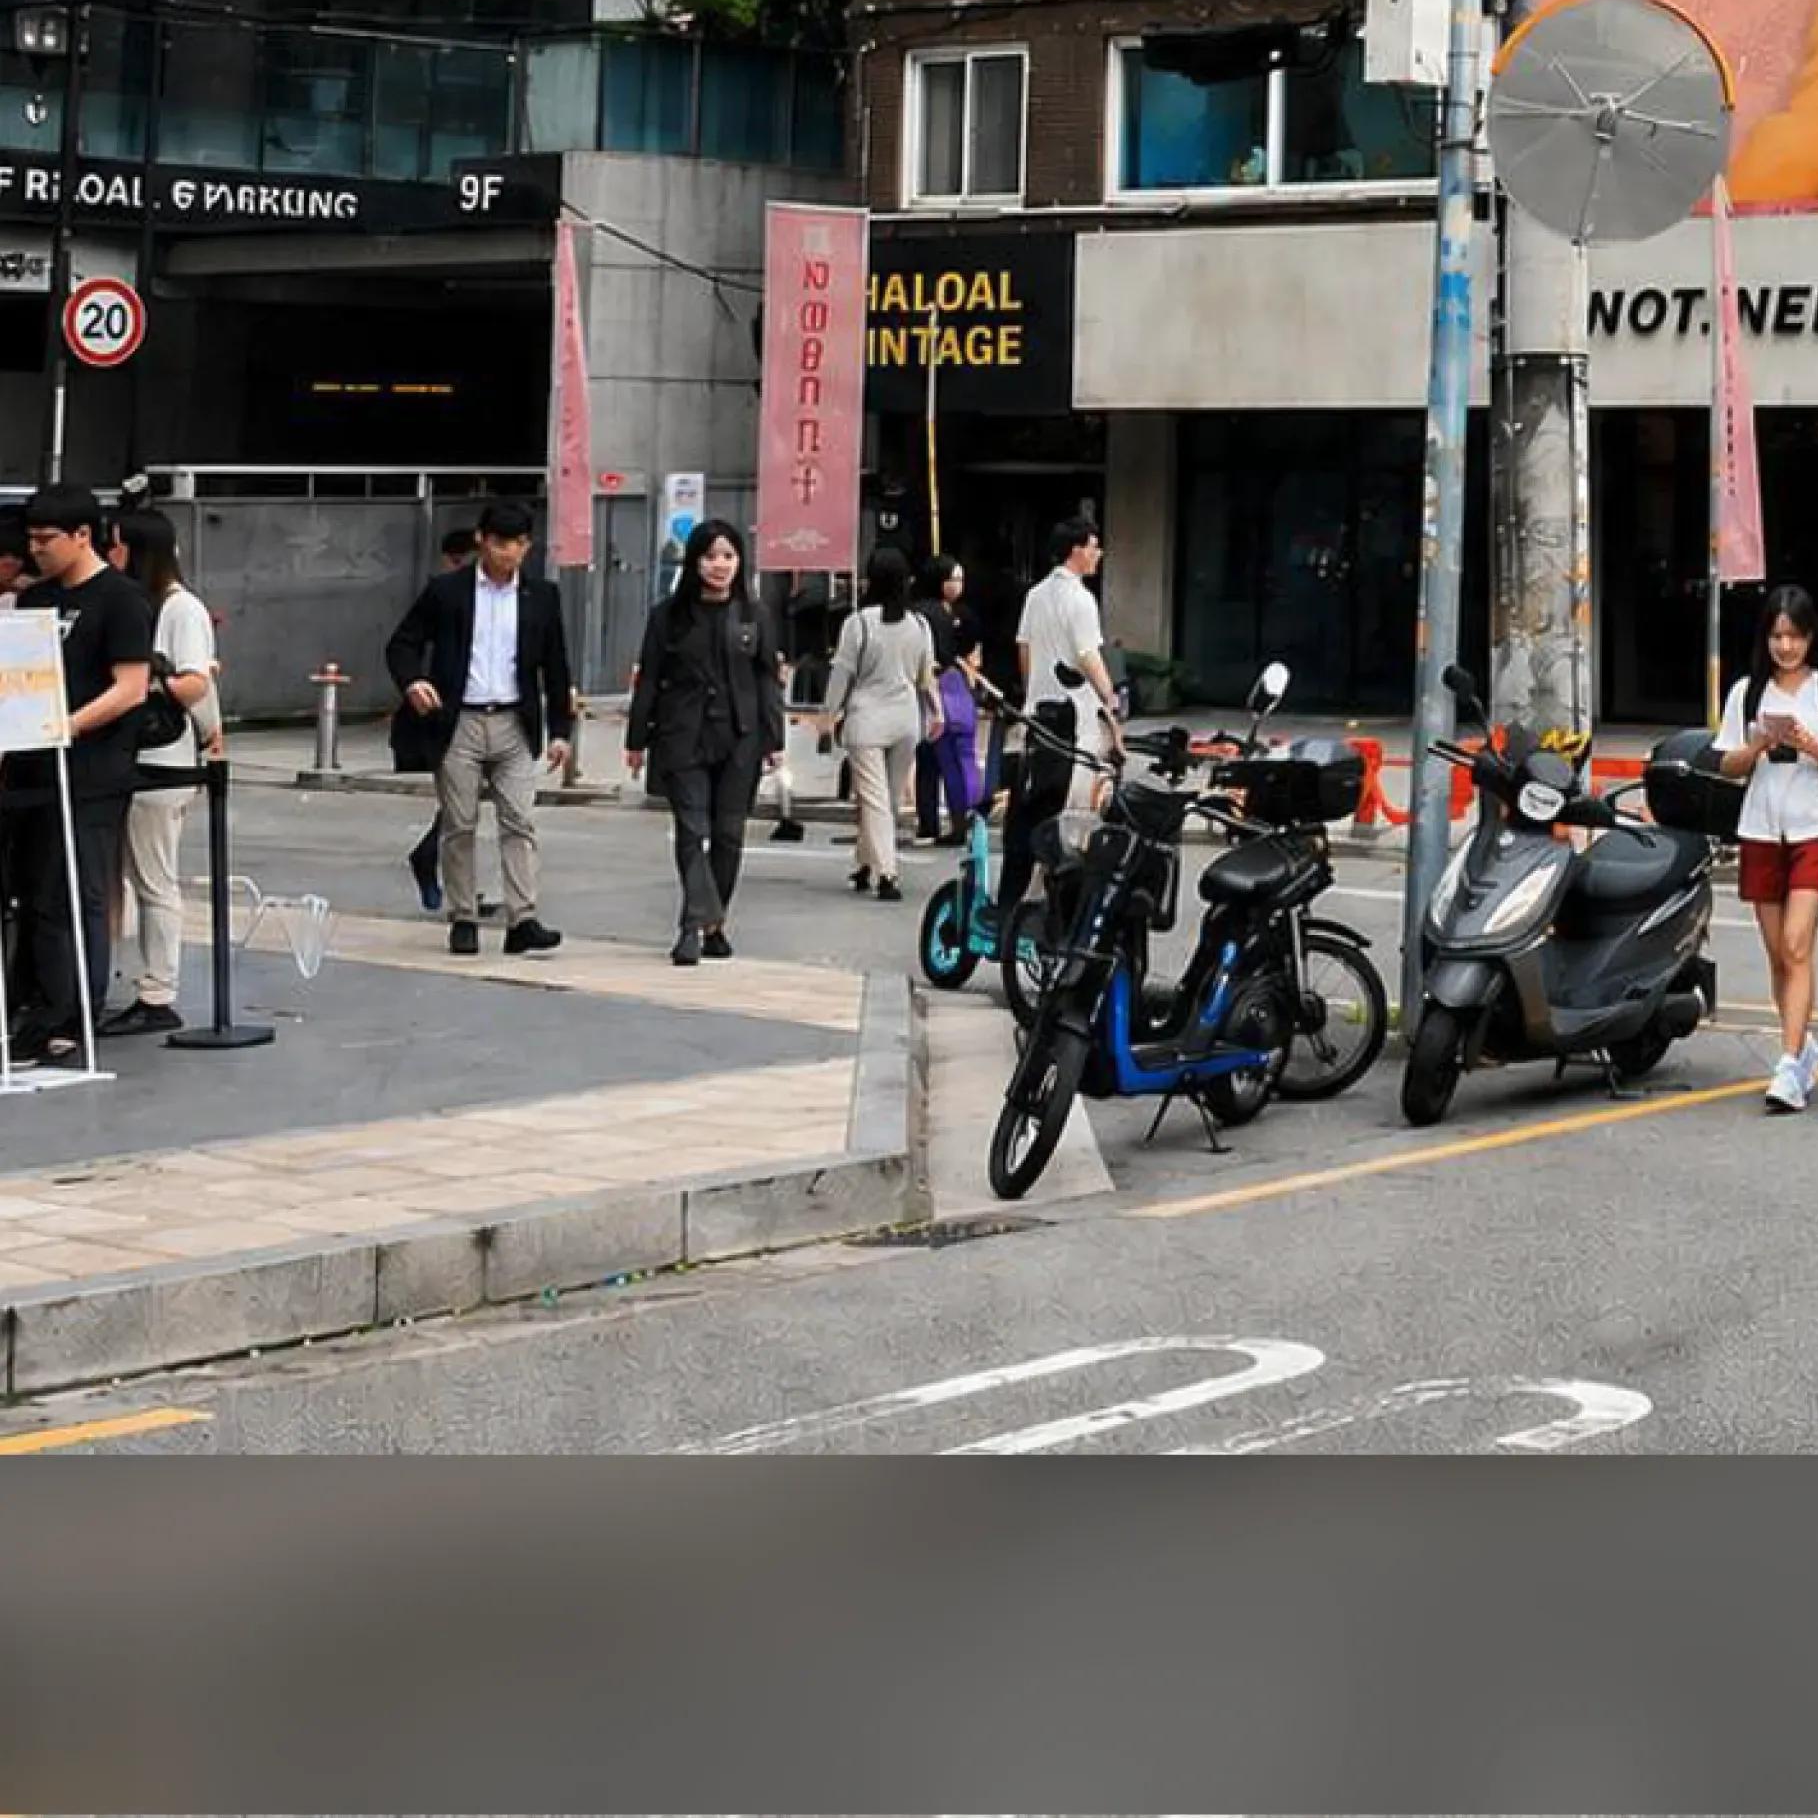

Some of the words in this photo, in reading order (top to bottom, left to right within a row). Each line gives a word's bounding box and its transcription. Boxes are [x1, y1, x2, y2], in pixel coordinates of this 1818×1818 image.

[459, 175, 503, 212] 9F
[82, 302, 127, 339] 20
[867, 325, 1022, 365] INTAGE
